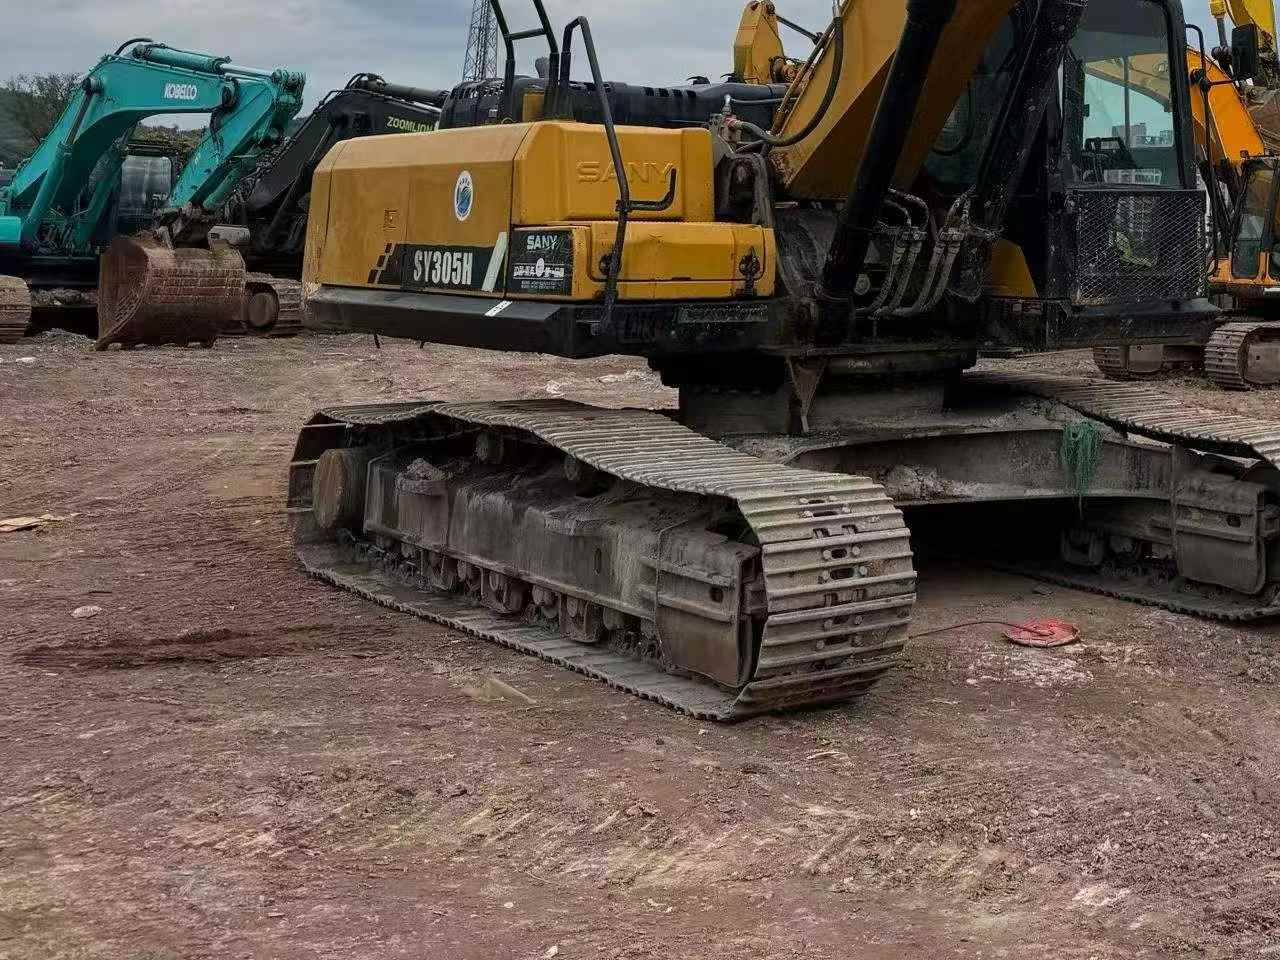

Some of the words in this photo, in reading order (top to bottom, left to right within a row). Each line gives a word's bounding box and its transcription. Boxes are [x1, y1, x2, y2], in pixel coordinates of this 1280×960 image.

[163, 83, 198, 100] KOBELCO
[387, 116, 434, 133] ZOOMLION
[526, 235, 558, 251] SANY
[413, 249, 474, 286] SY305H
